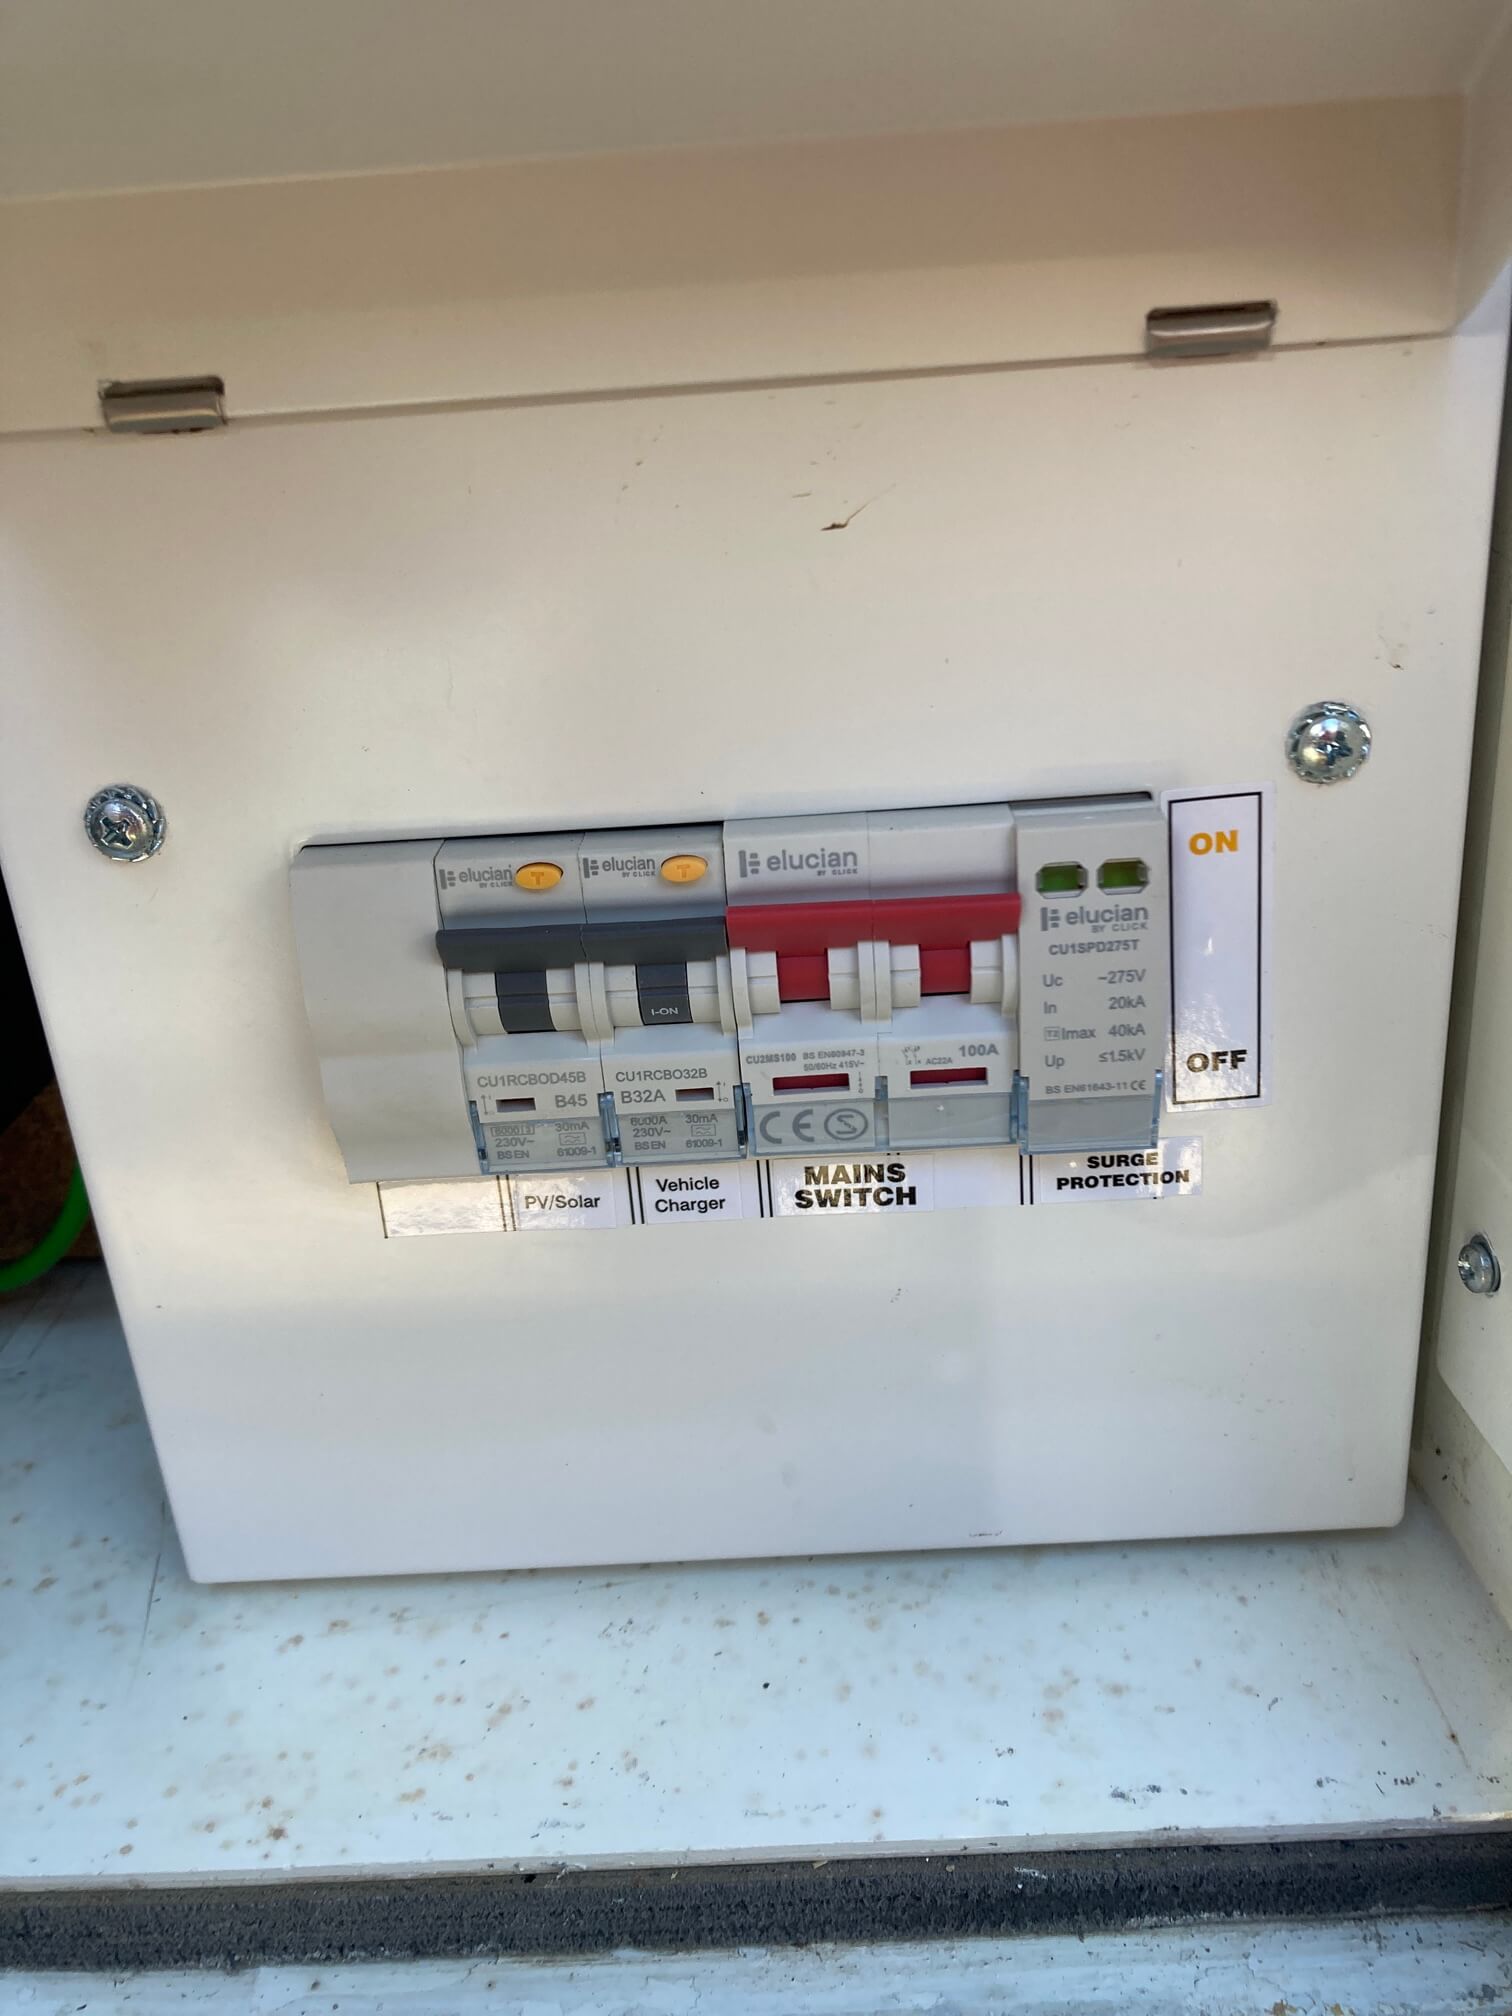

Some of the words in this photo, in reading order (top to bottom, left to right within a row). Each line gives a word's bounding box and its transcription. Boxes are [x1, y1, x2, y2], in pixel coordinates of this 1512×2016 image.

[1189, 829, 1239, 855] ON
[602, 857, 656, 872] elucian
[767, 847, 858, 871] elucian
[459, 866, 513, 883] elucian
[530, 871, 544, 885] T
[634, 870, 656, 878] CLICK
[677, 865, 690, 878] T
[1066, 905, 1149, 926] elucian
[1091, 924, 1105, 933] BY
[1112, 922, 1149, 932] CLICK
[1049, 939, 1140, 955] CU1SPD275T
[1043, 974, 1063, 987] Uc
[650, 1007, 679, 1016] I-ON
[1044, 1001, 1057, 1014] In
[1108, 995, 1146, 1010] 20kA
[1062, 1026, 1096, 1040] Imax
[1108, 1023, 1146, 1037] 40kA
[746, 1052, 796, 1064] CU2MS100
[803, 1051, 815, 1060] BS
[959, 1044, 999, 1057] 100A
[803, 1063, 837, 1071] 50/60Hz
[926, 1057, 953, 1065] AC22A
[1045, 1054, 1065, 1069] Up
[1186, 1049, 1247, 1073] OFF
[477, 1071, 587, 1088] CU1RCBOD45B
[616, 1068, 708, 1082] CU1RCBO32B
[1045, 1085, 1061, 1094] BS
[1064, 1081, 1128, 1094] EN61643-11
[555, 1094, 588, 1108] B45
[621, 1089, 666, 1103] B32A
[685, 1113, 718, 1124] 30mA
[555, 1121, 590, 1132] 30mA
[686, 1138, 723, 1148] 61009-1
[557, 1146, 597, 1157] 61009-1
[1087, 1152, 1158, 1169] SURGE
[804, 1163, 906, 1185] MAINS
[1056, 1169, 1189, 1191] PROTECTION
[655, 1176, 720, 1193] Vehicle
[524, 1195, 601, 1210] PV/Solar
[795, 1186, 916, 1208] SWITCH
[654, 1196, 726, 1214] Charger
